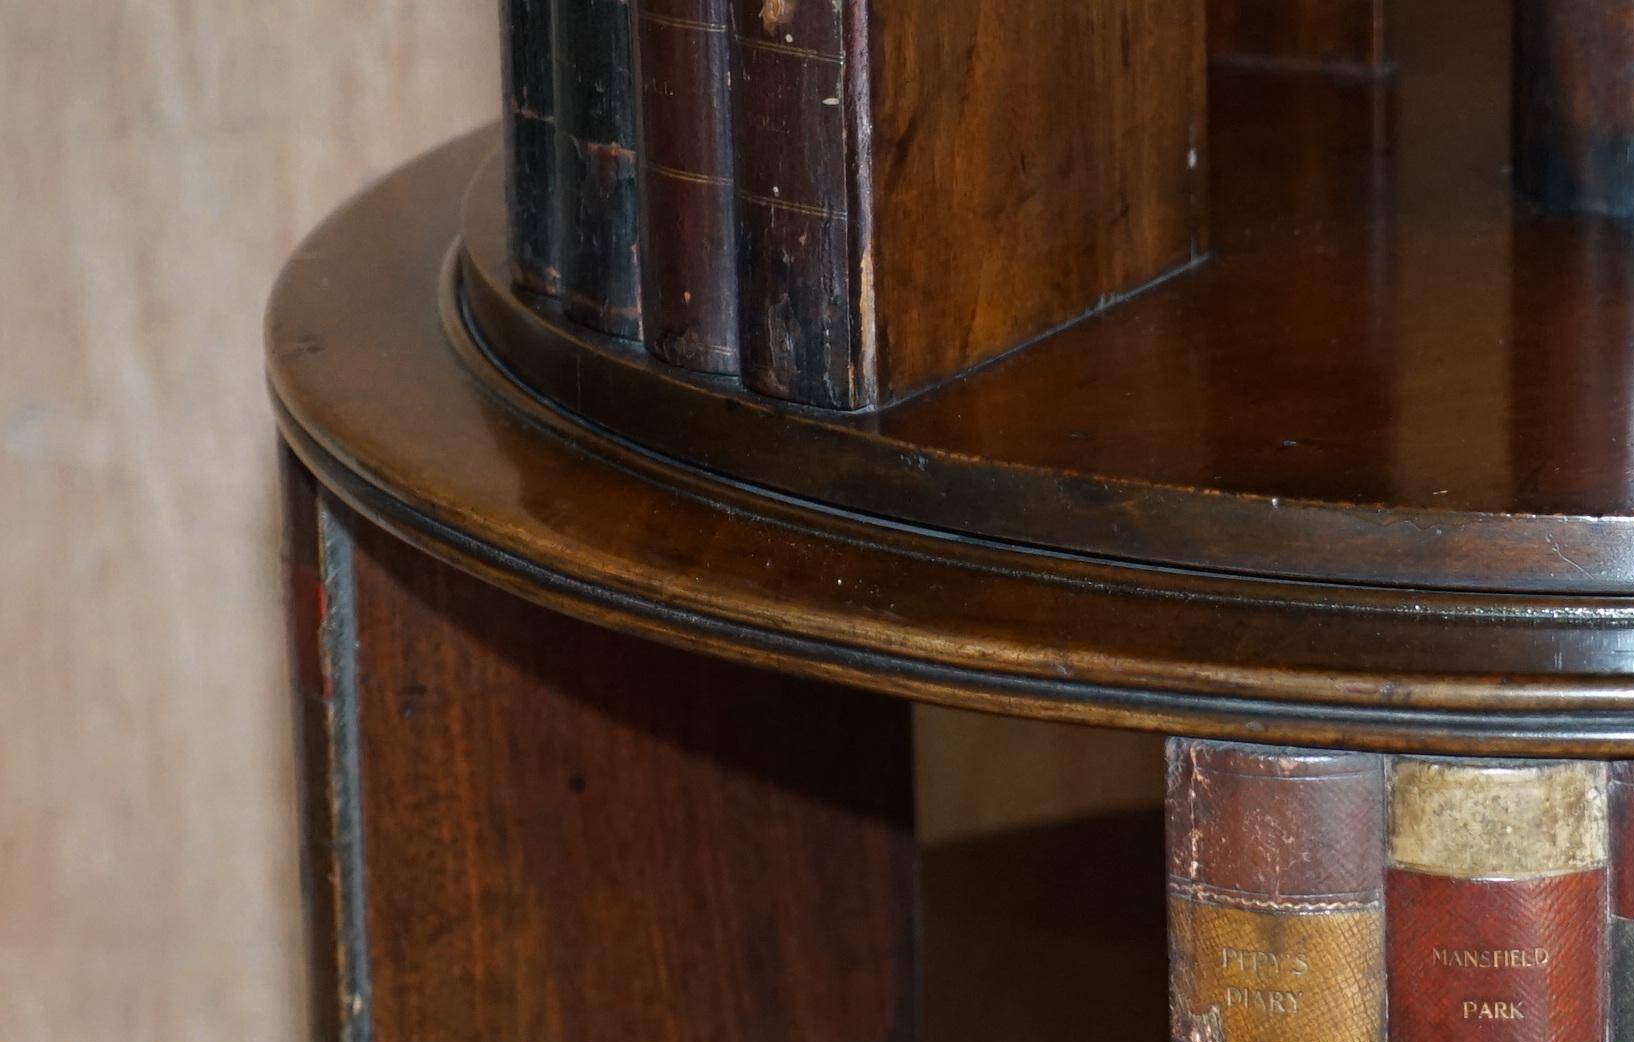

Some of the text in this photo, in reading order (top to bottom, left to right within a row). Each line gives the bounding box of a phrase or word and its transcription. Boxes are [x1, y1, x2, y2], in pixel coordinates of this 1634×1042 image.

[1431, 946, 1549, 969] MANSFIELD
[1226, 986, 1303, 1014] DIARY
[1463, 1001, 1525, 1019] PARK
